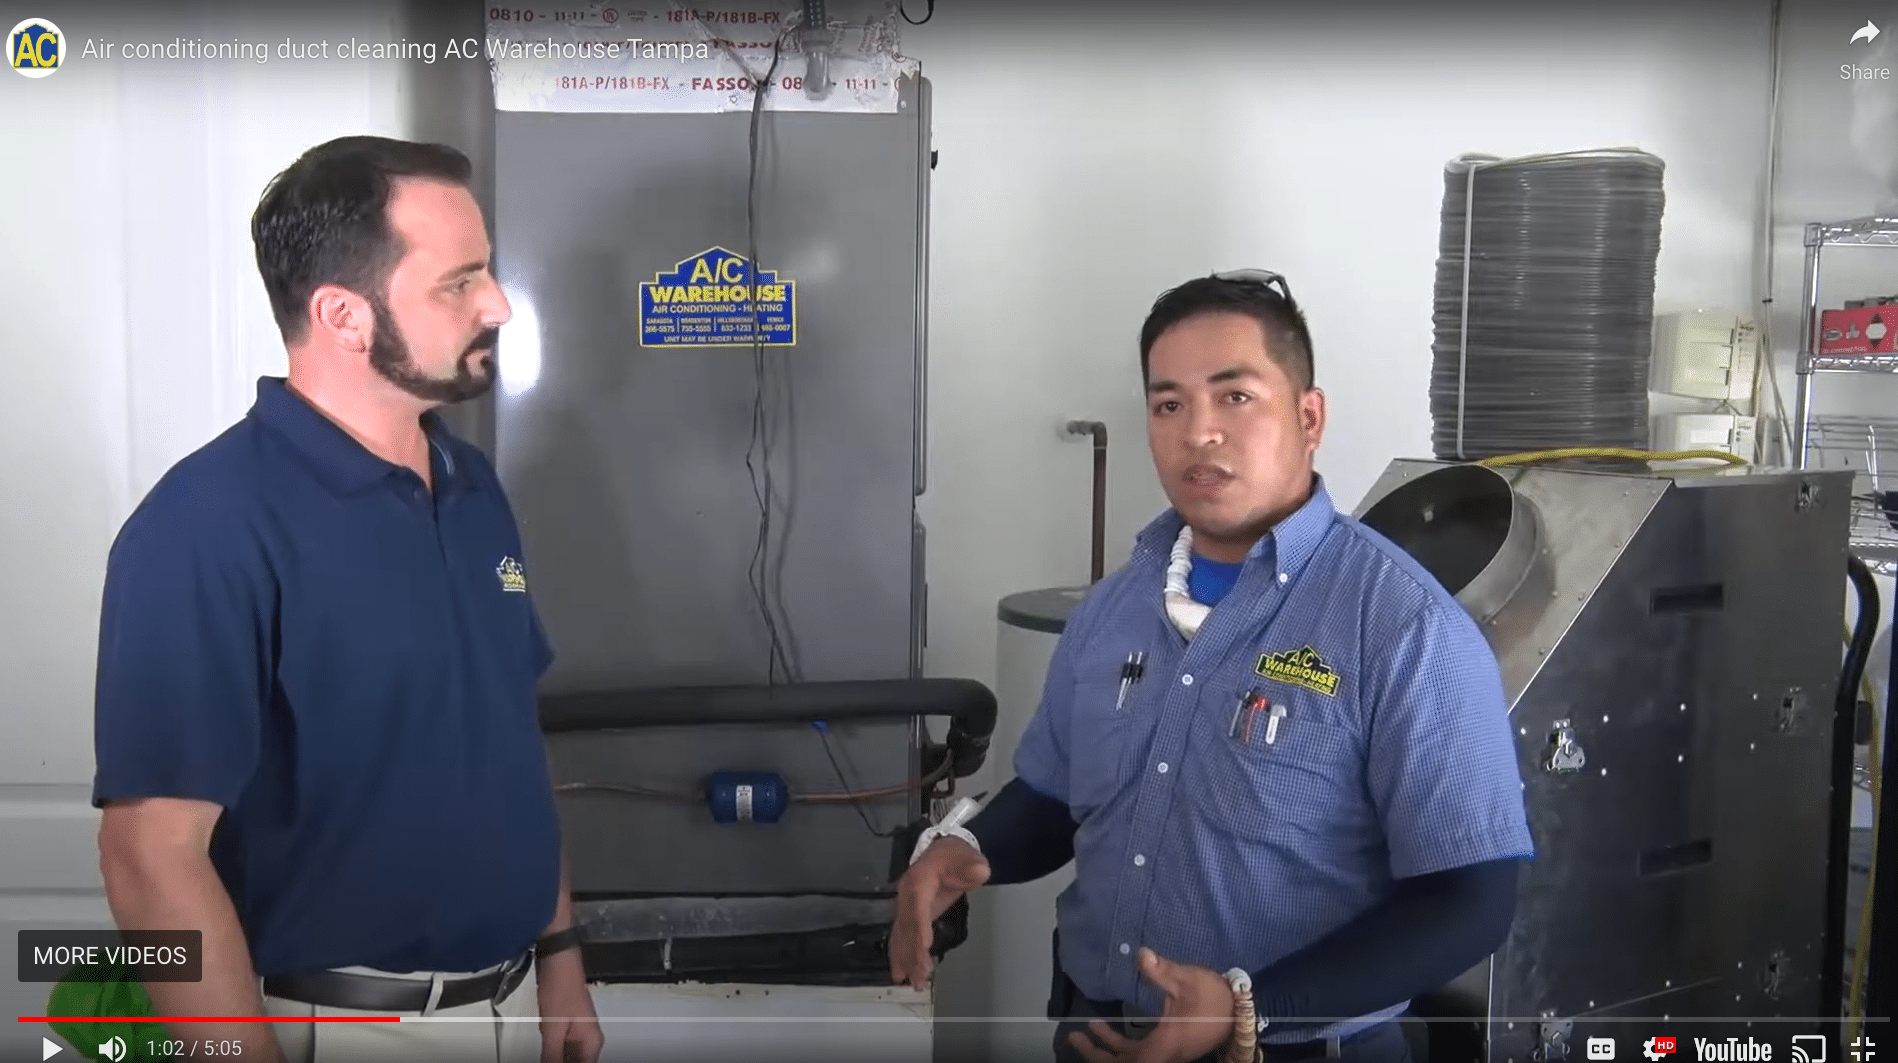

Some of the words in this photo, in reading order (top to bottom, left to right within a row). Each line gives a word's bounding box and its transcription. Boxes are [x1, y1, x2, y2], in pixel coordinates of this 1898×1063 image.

[489, 8, 534, 22] 0810
[691, 77, 757, 91] FASSO
[690, 257, 743, 284] A/C
[649, 285, 786, 303] WAREHOUSE
[652, 305, 668, 314] AIR
[669, 304, 736, 313] CONDITIONING
[681, 335, 696, 343] MAY
[1287, 651, 1315, 667] A/C
[1265, 657, 1337, 688] WAREHOUSE
